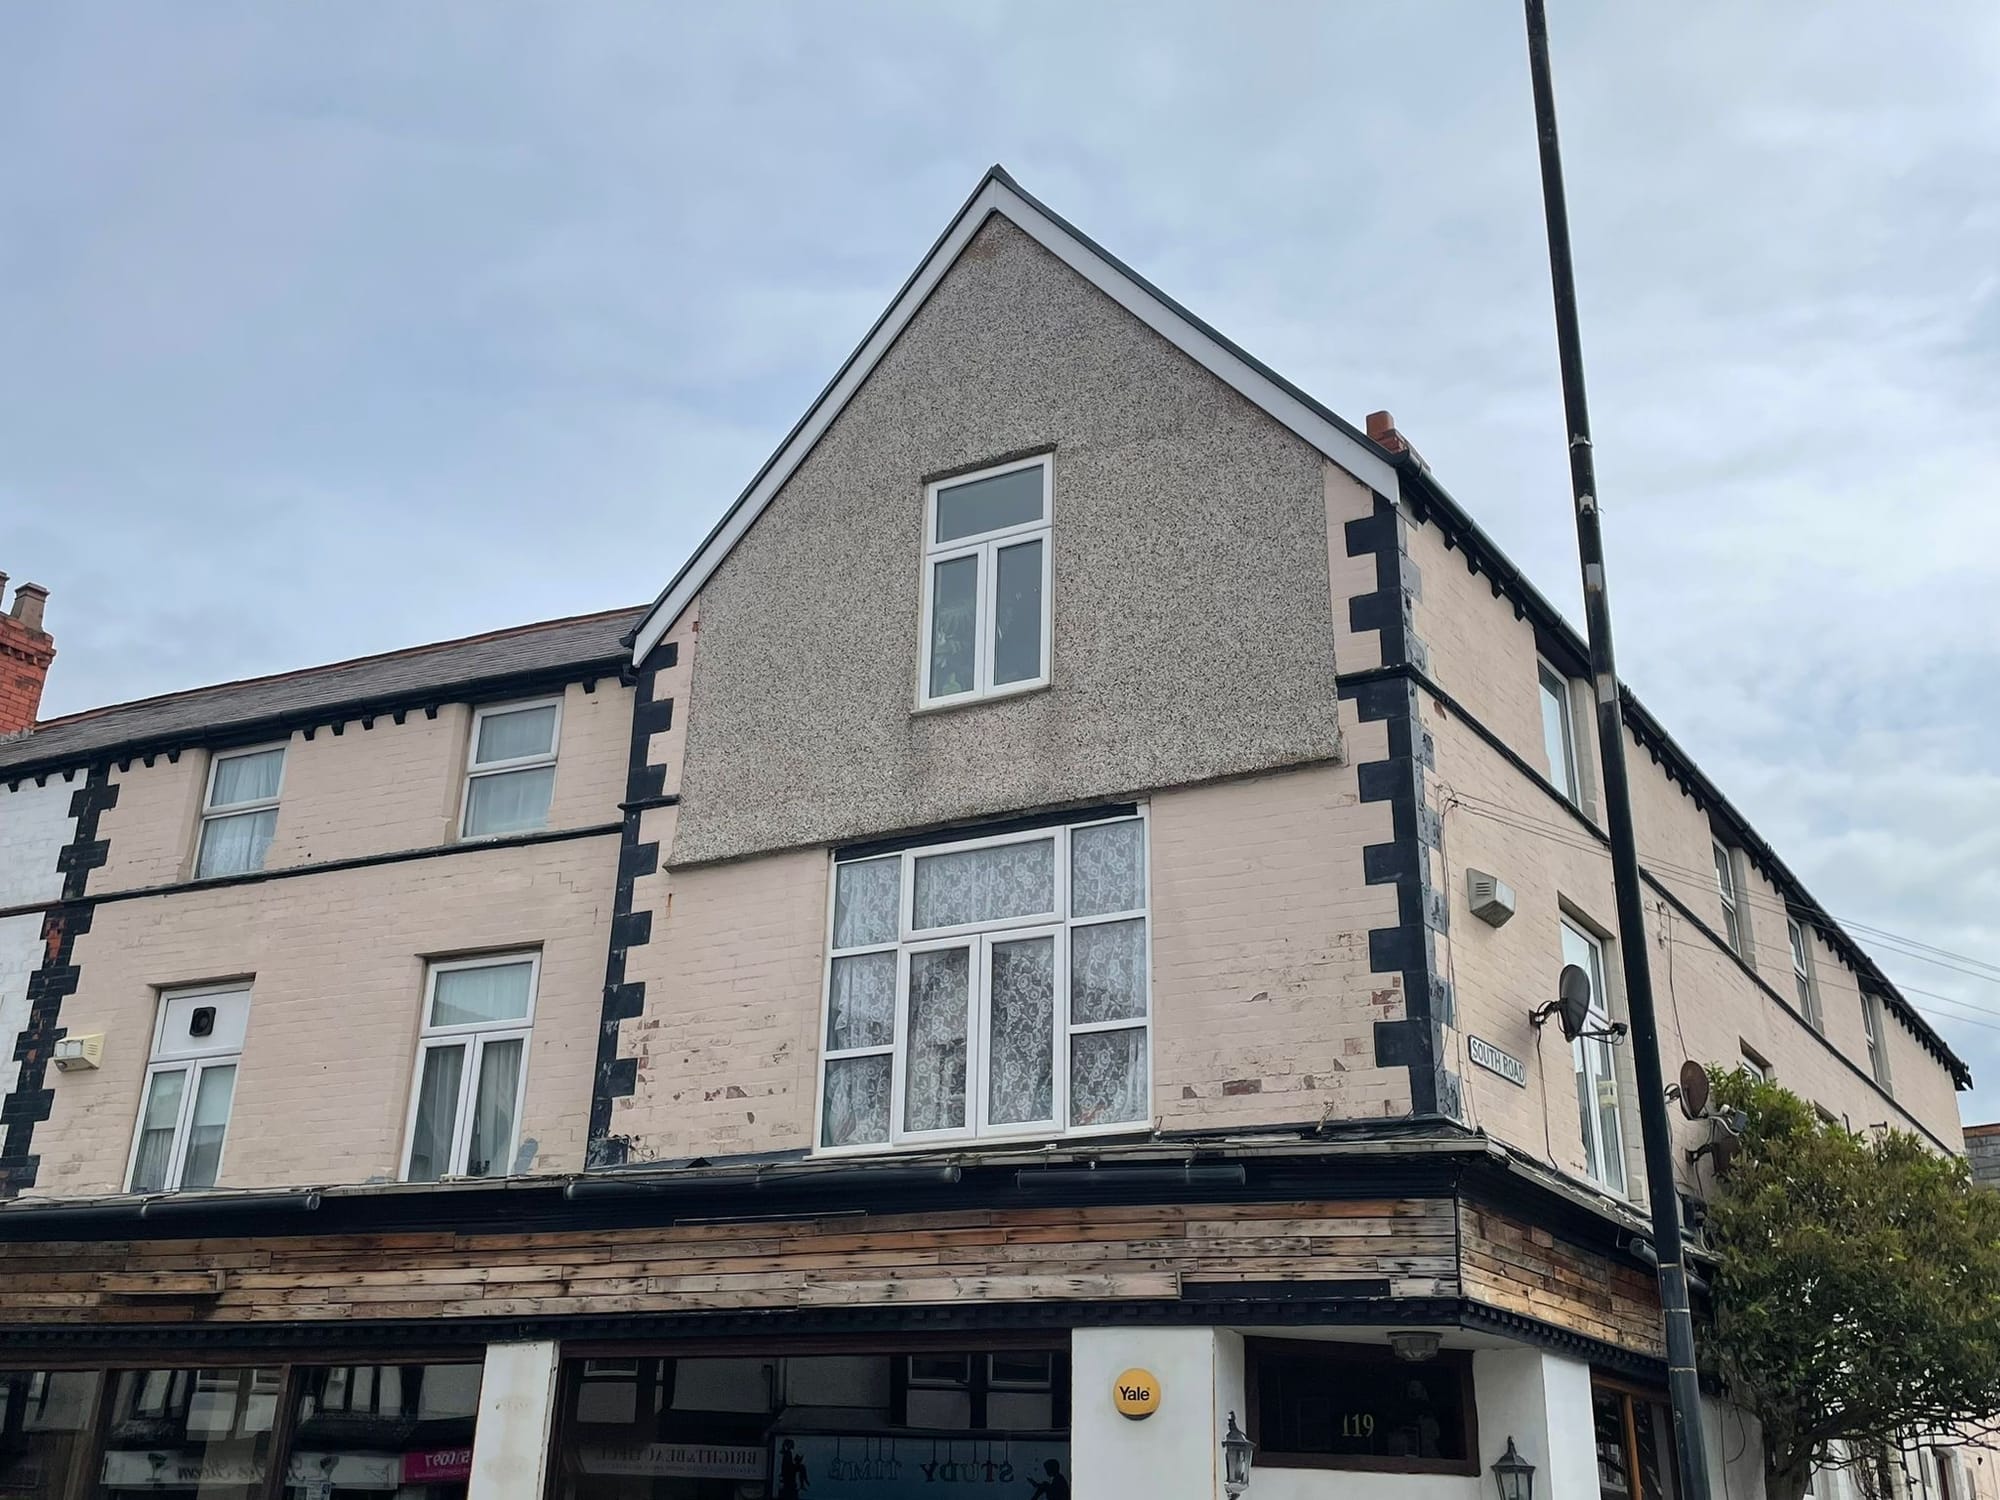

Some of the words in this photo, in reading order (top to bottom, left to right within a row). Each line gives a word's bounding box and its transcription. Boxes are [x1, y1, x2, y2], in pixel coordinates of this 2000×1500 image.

[1472, 1040, 1501, 1072] SOUTH
[1503, 1056, 1524, 1082] ROAD
[1119, 1386, 1150, 1401] Yale
[1342, 1412, 1374, 1437] 119
